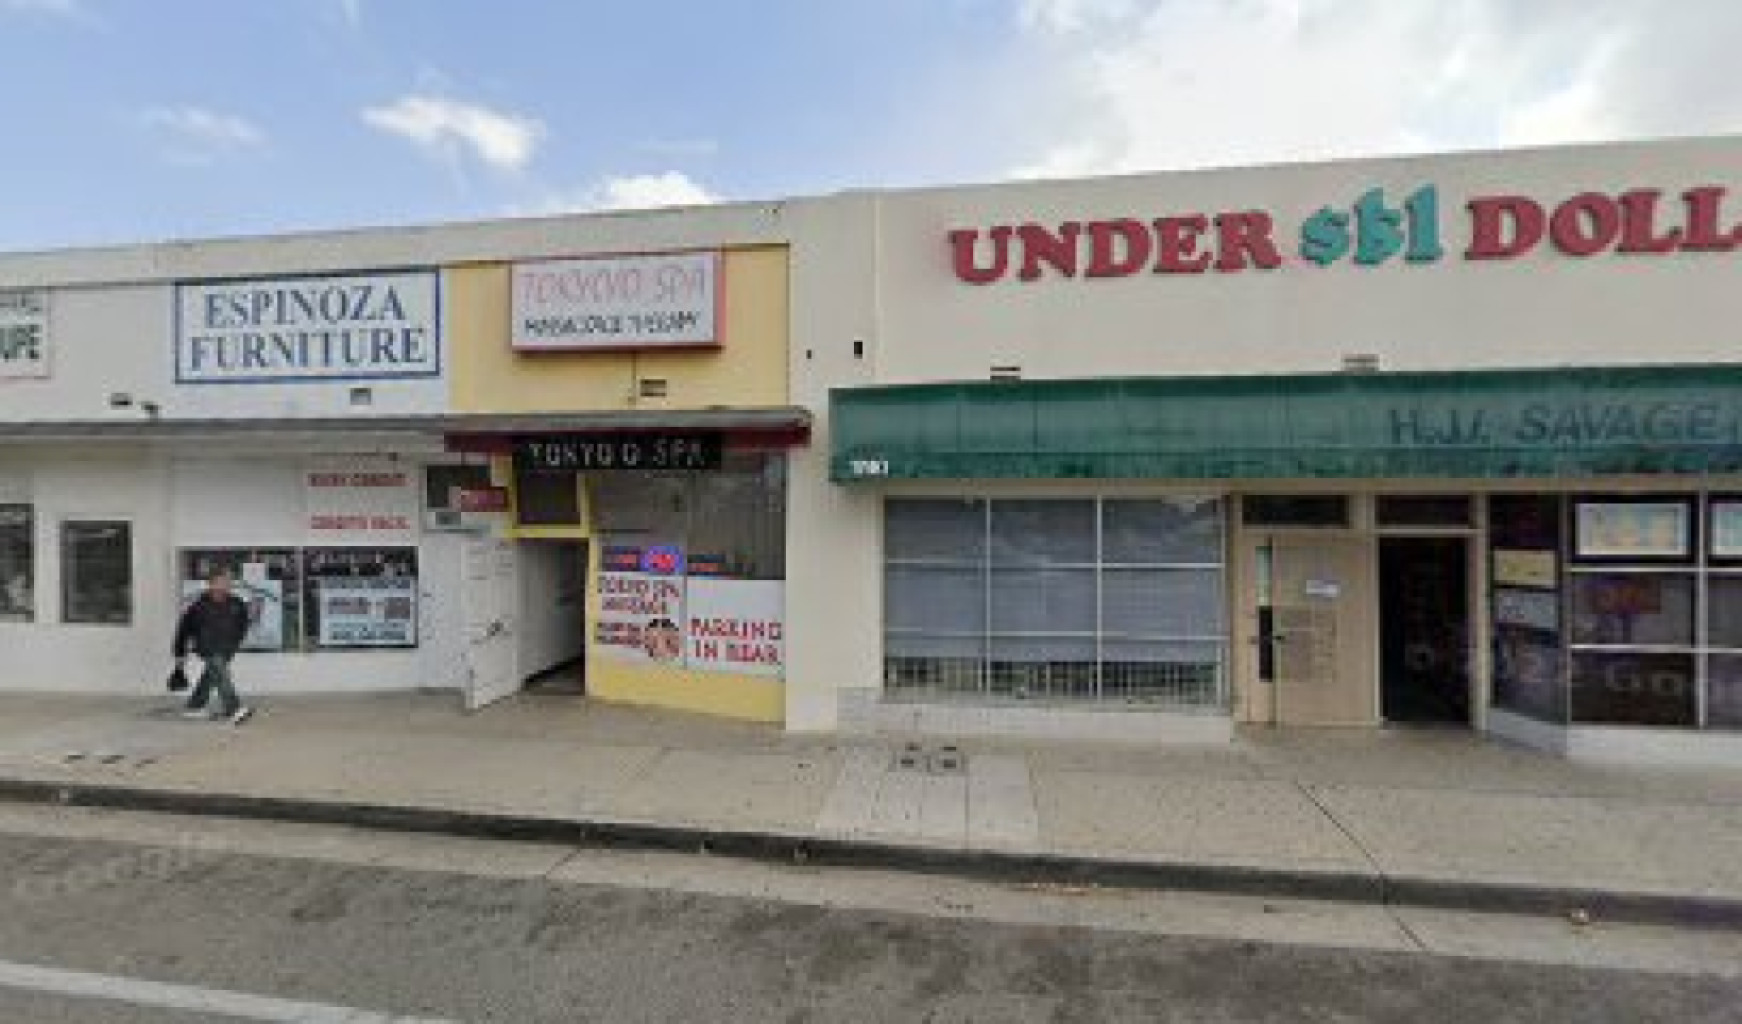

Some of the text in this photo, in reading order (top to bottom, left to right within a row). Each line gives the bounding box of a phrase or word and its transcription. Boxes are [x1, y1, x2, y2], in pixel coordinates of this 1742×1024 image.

[951, 210, 1282, 284] UNDER
[203, 284, 407, 329] ESPINOZA
[190, 327, 429, 372] FURNITURE
[1514, 403, 1723, 442] SAVAGE
[691, 618, 782, 640] PARKING
[695, 640, 719, 660] IN
